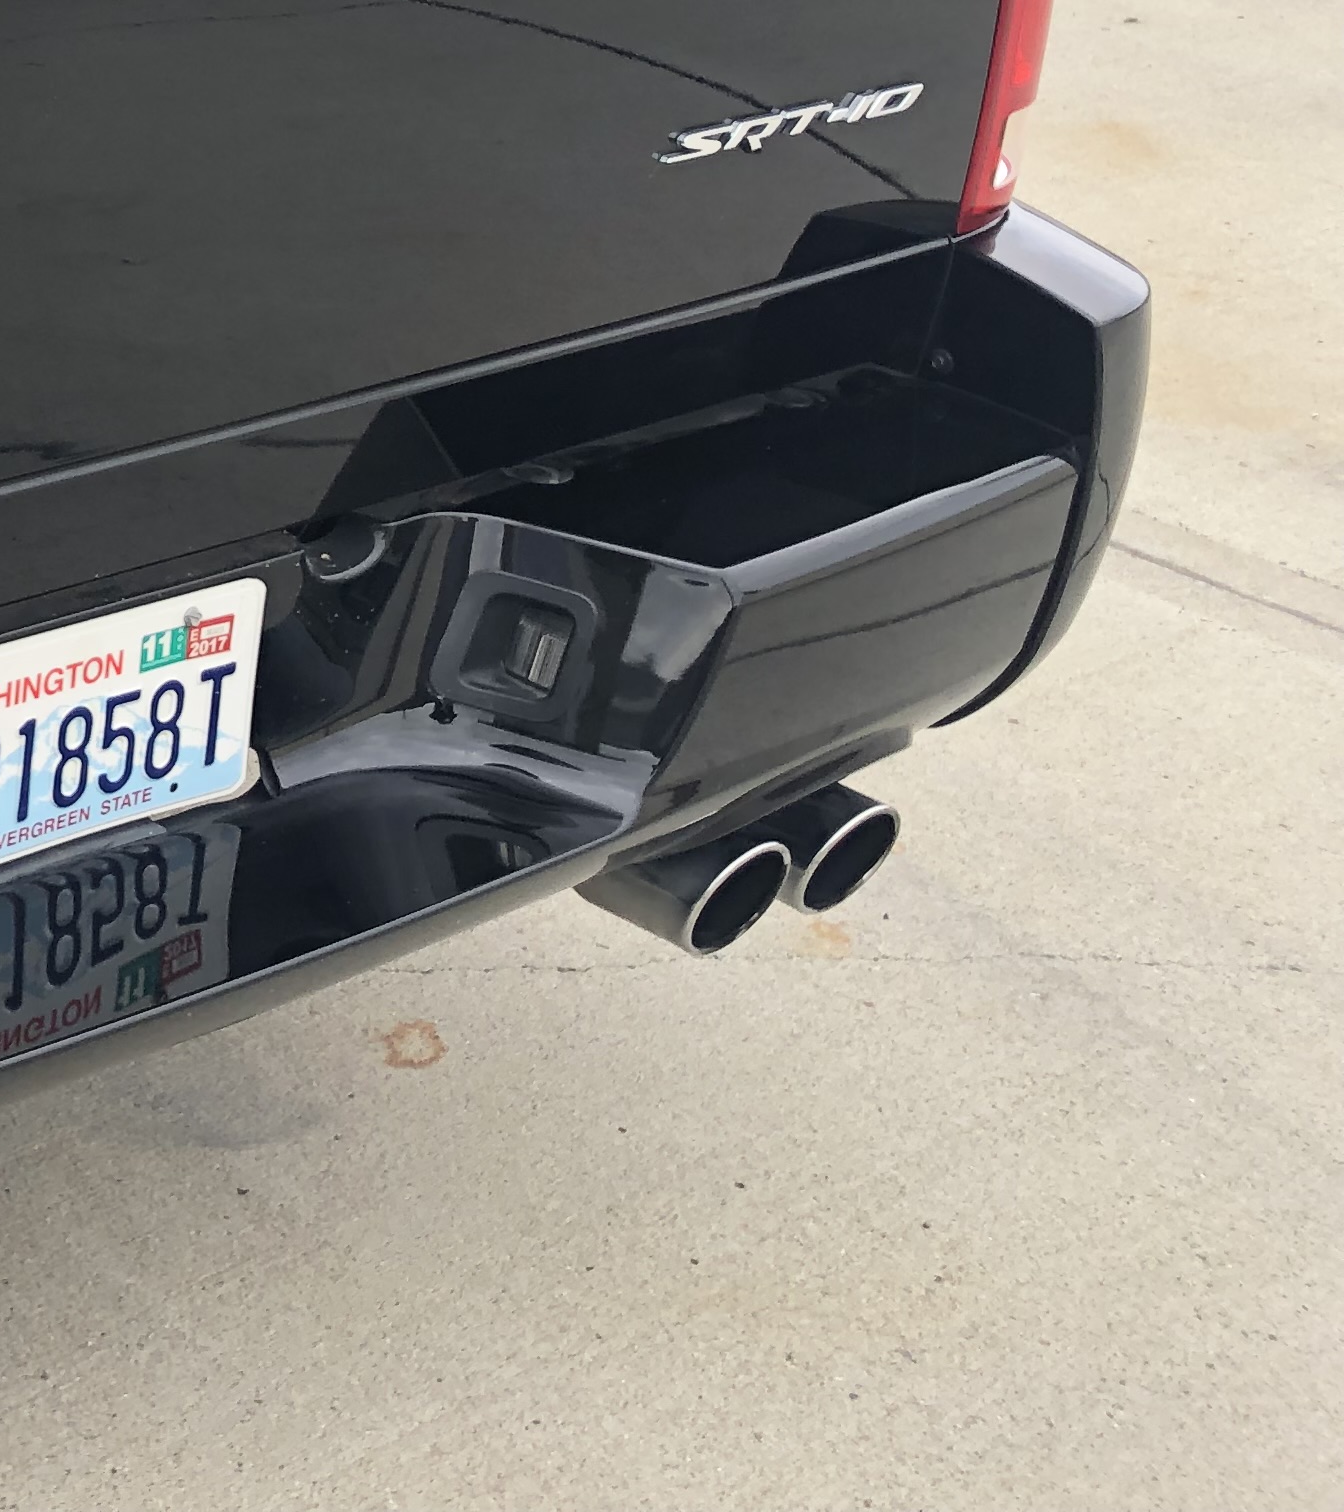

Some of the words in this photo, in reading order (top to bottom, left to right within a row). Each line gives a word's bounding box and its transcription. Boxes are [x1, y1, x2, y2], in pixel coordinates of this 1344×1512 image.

[143, 629, 172, 662] 11
[188, 635, 229, 658] 2017
[100, 787, 153, 816] STATE
